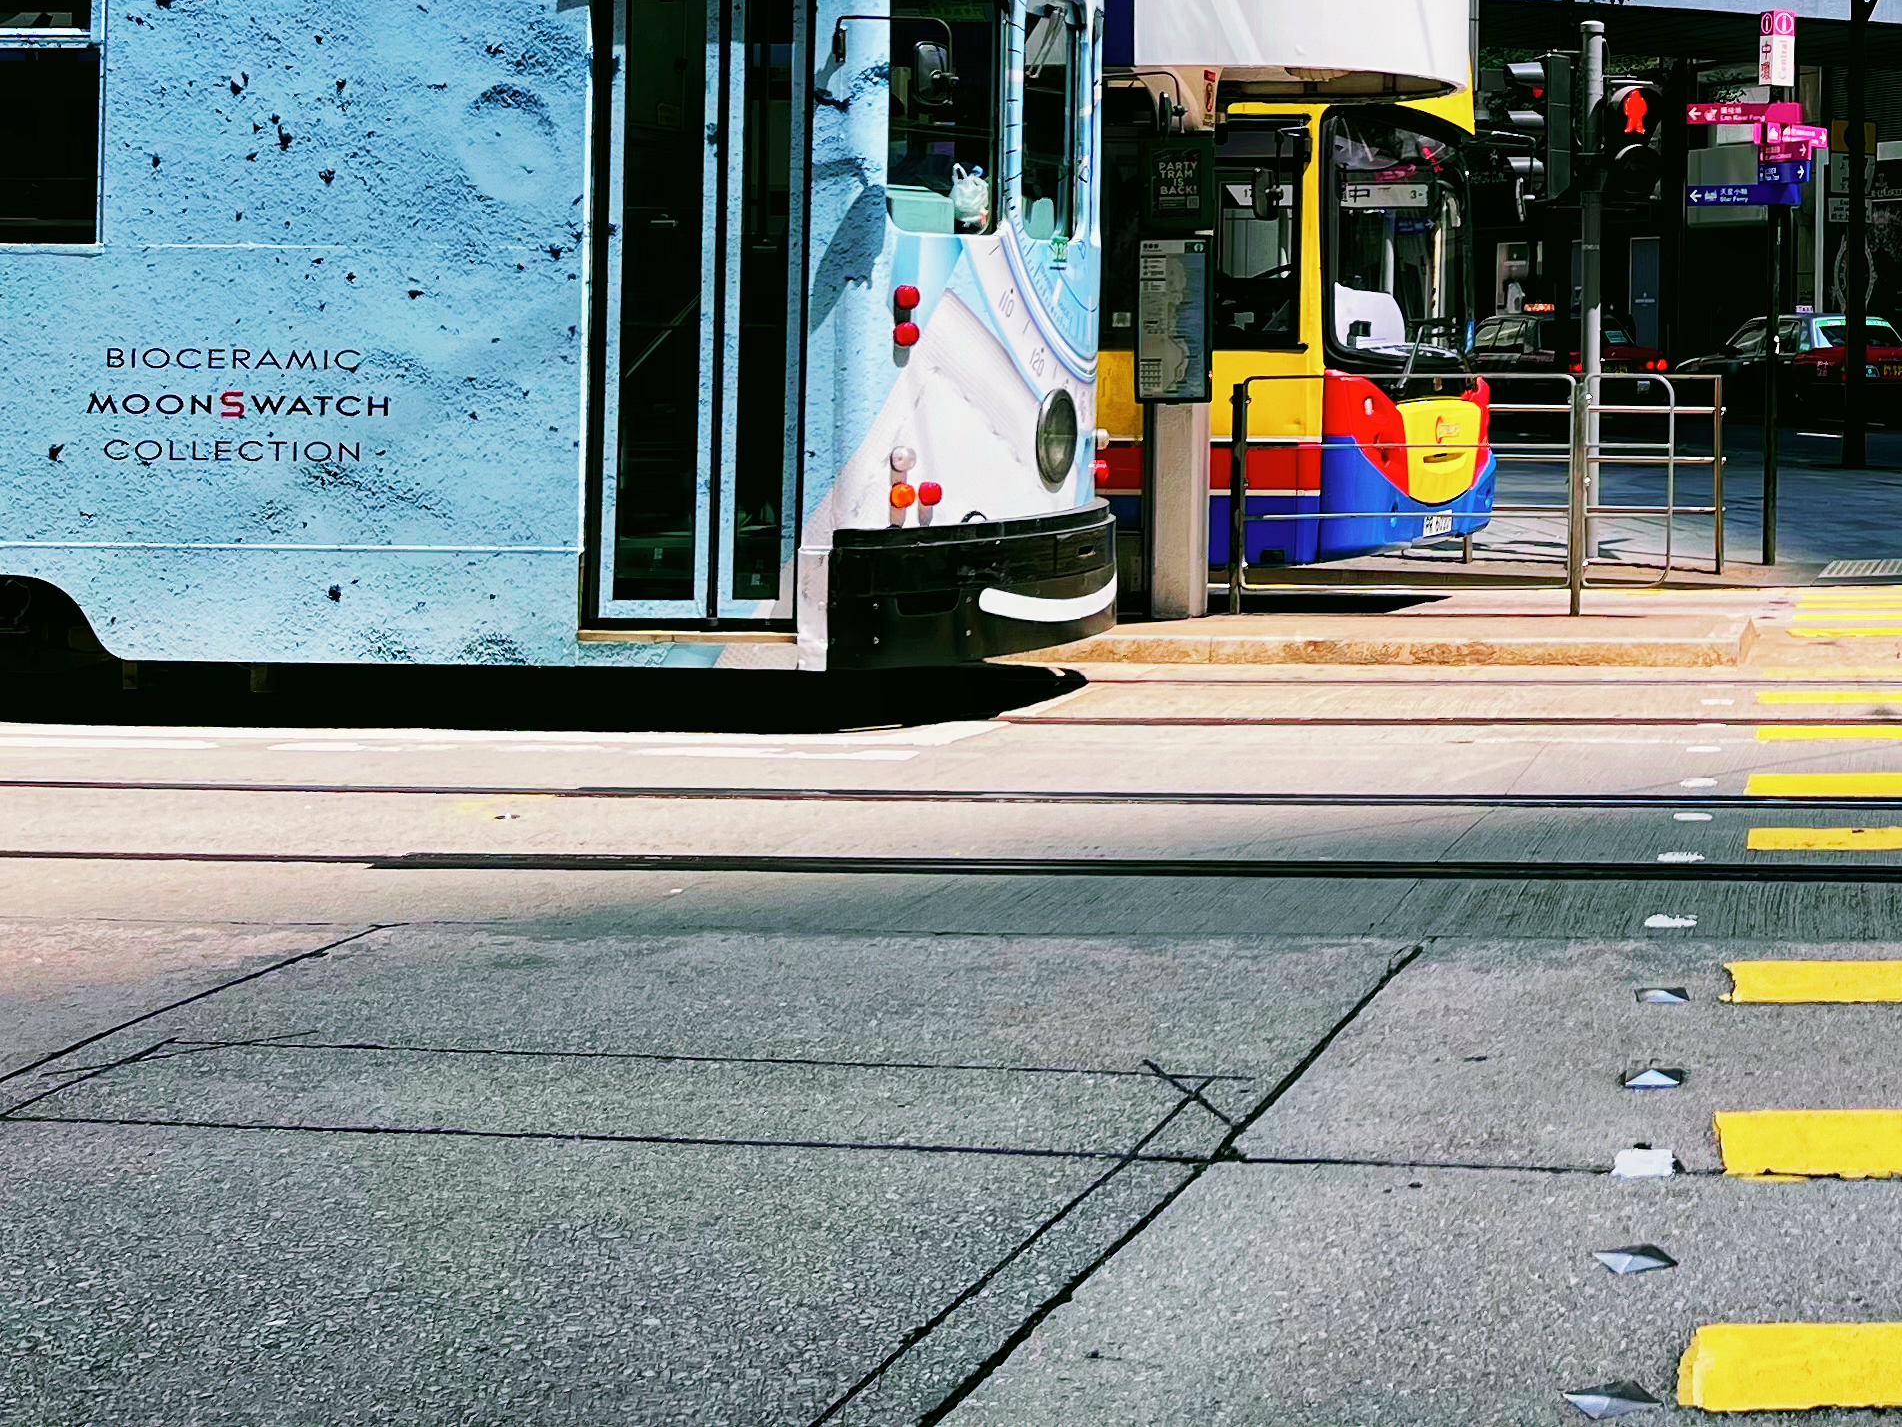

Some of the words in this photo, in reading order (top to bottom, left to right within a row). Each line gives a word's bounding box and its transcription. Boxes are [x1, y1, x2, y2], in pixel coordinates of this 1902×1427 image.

[1778, 40, 1788, 80] Central
[1158, 161, 1198, 171] PARTY
[1159, 169, 1193, 179] TRAM
[1160, 185, 1197, 194] BACK!
[1173, 178, 1184, 187] IS
[106, 347, 361, 372] BIOCERAMIC
[86, 391, 389, 419] MOONSWATCH
[103, 439, 361, 463] COLLECTION
